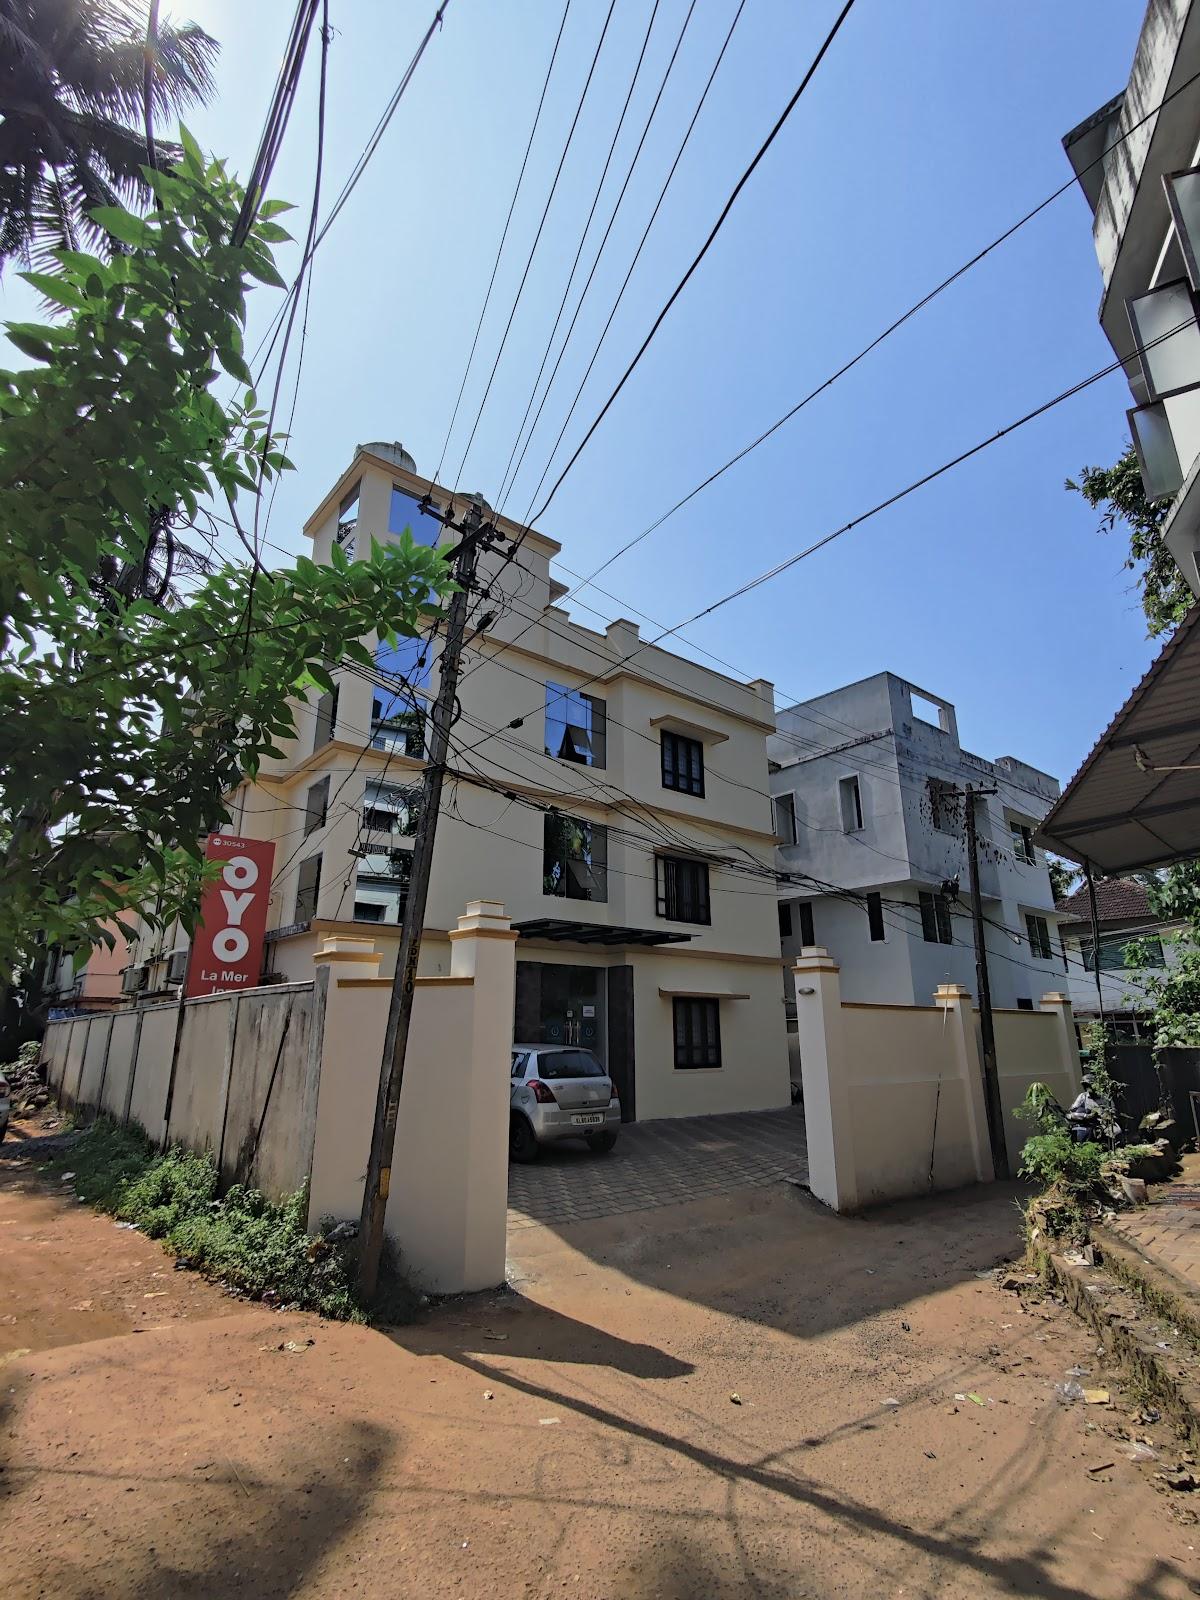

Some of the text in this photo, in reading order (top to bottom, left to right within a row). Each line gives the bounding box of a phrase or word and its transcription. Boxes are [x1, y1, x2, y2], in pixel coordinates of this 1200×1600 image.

[212, 855, 259, 963] OYO
[201, 969, 249, 982] La Mer
[212, 986, 233, 994] In
